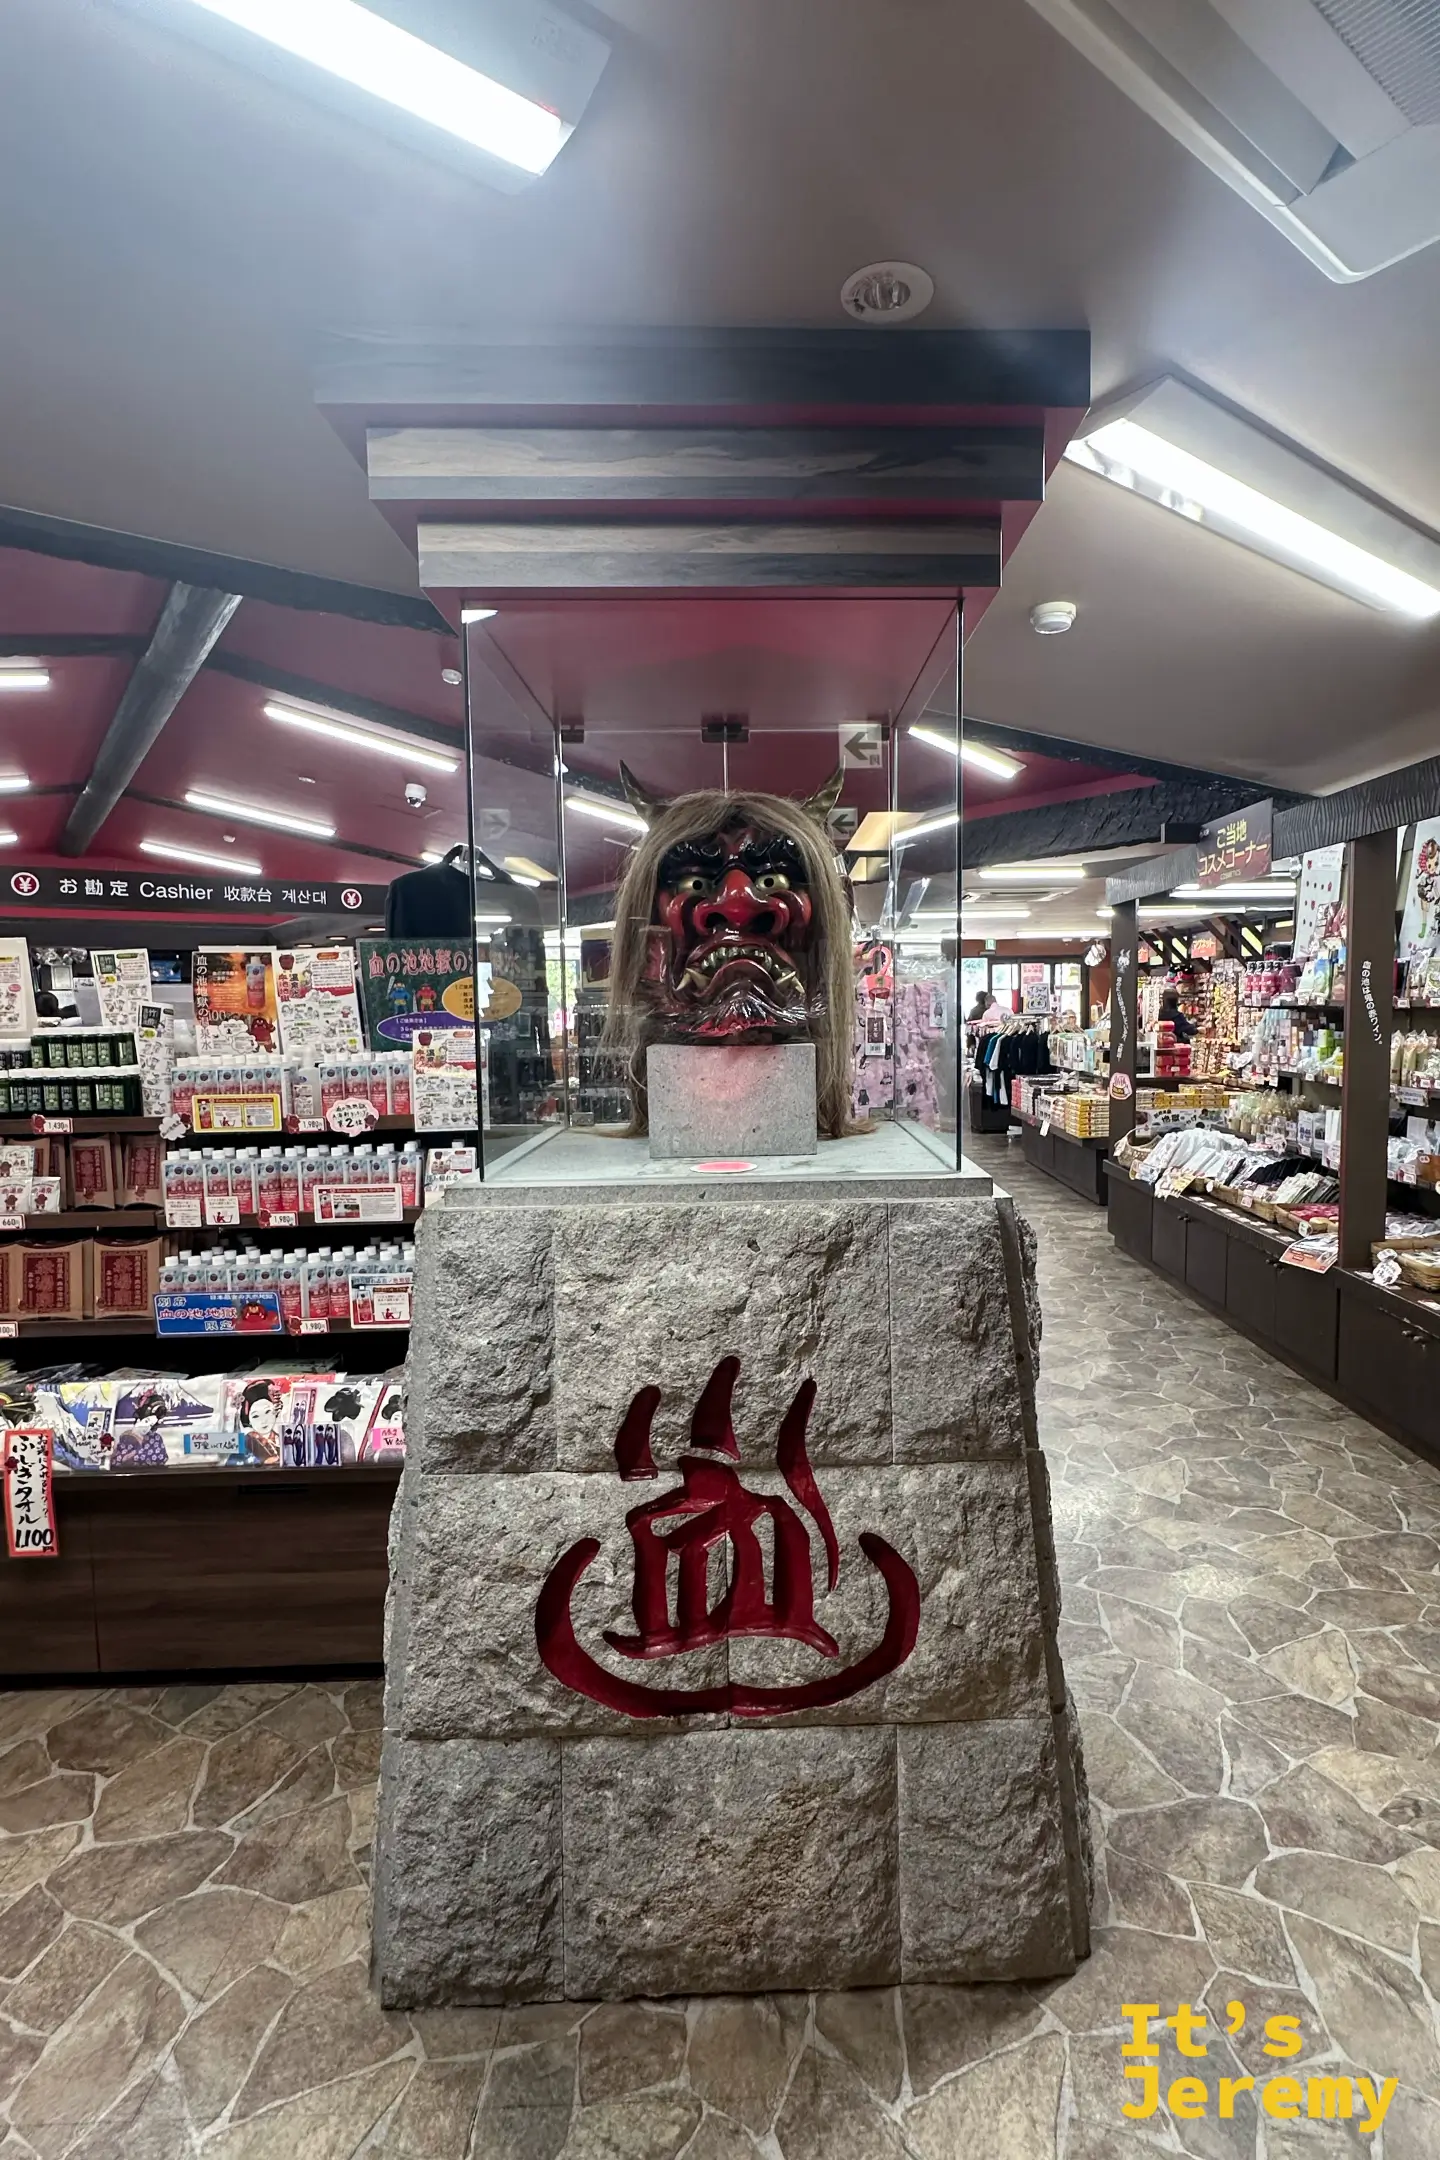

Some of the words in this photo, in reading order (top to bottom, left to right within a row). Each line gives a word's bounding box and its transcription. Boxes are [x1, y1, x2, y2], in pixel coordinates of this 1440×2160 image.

[1216, 818, 1247, 849] ご当地
[1199, 840, 1268, 876] コスメコーナー
[59, 878, 129, 898] お勘定
[139, 881, 214, 901] Cashier
[281, 888, 328, 906] 계산대
[158, 1297, 186, 1307] 別府
[159, 1307, 237, 1320] 血の池地獄
[204, 1320, 236, 1331] 限定
[12, 1435, 41, 1525] ふしぎタオル
